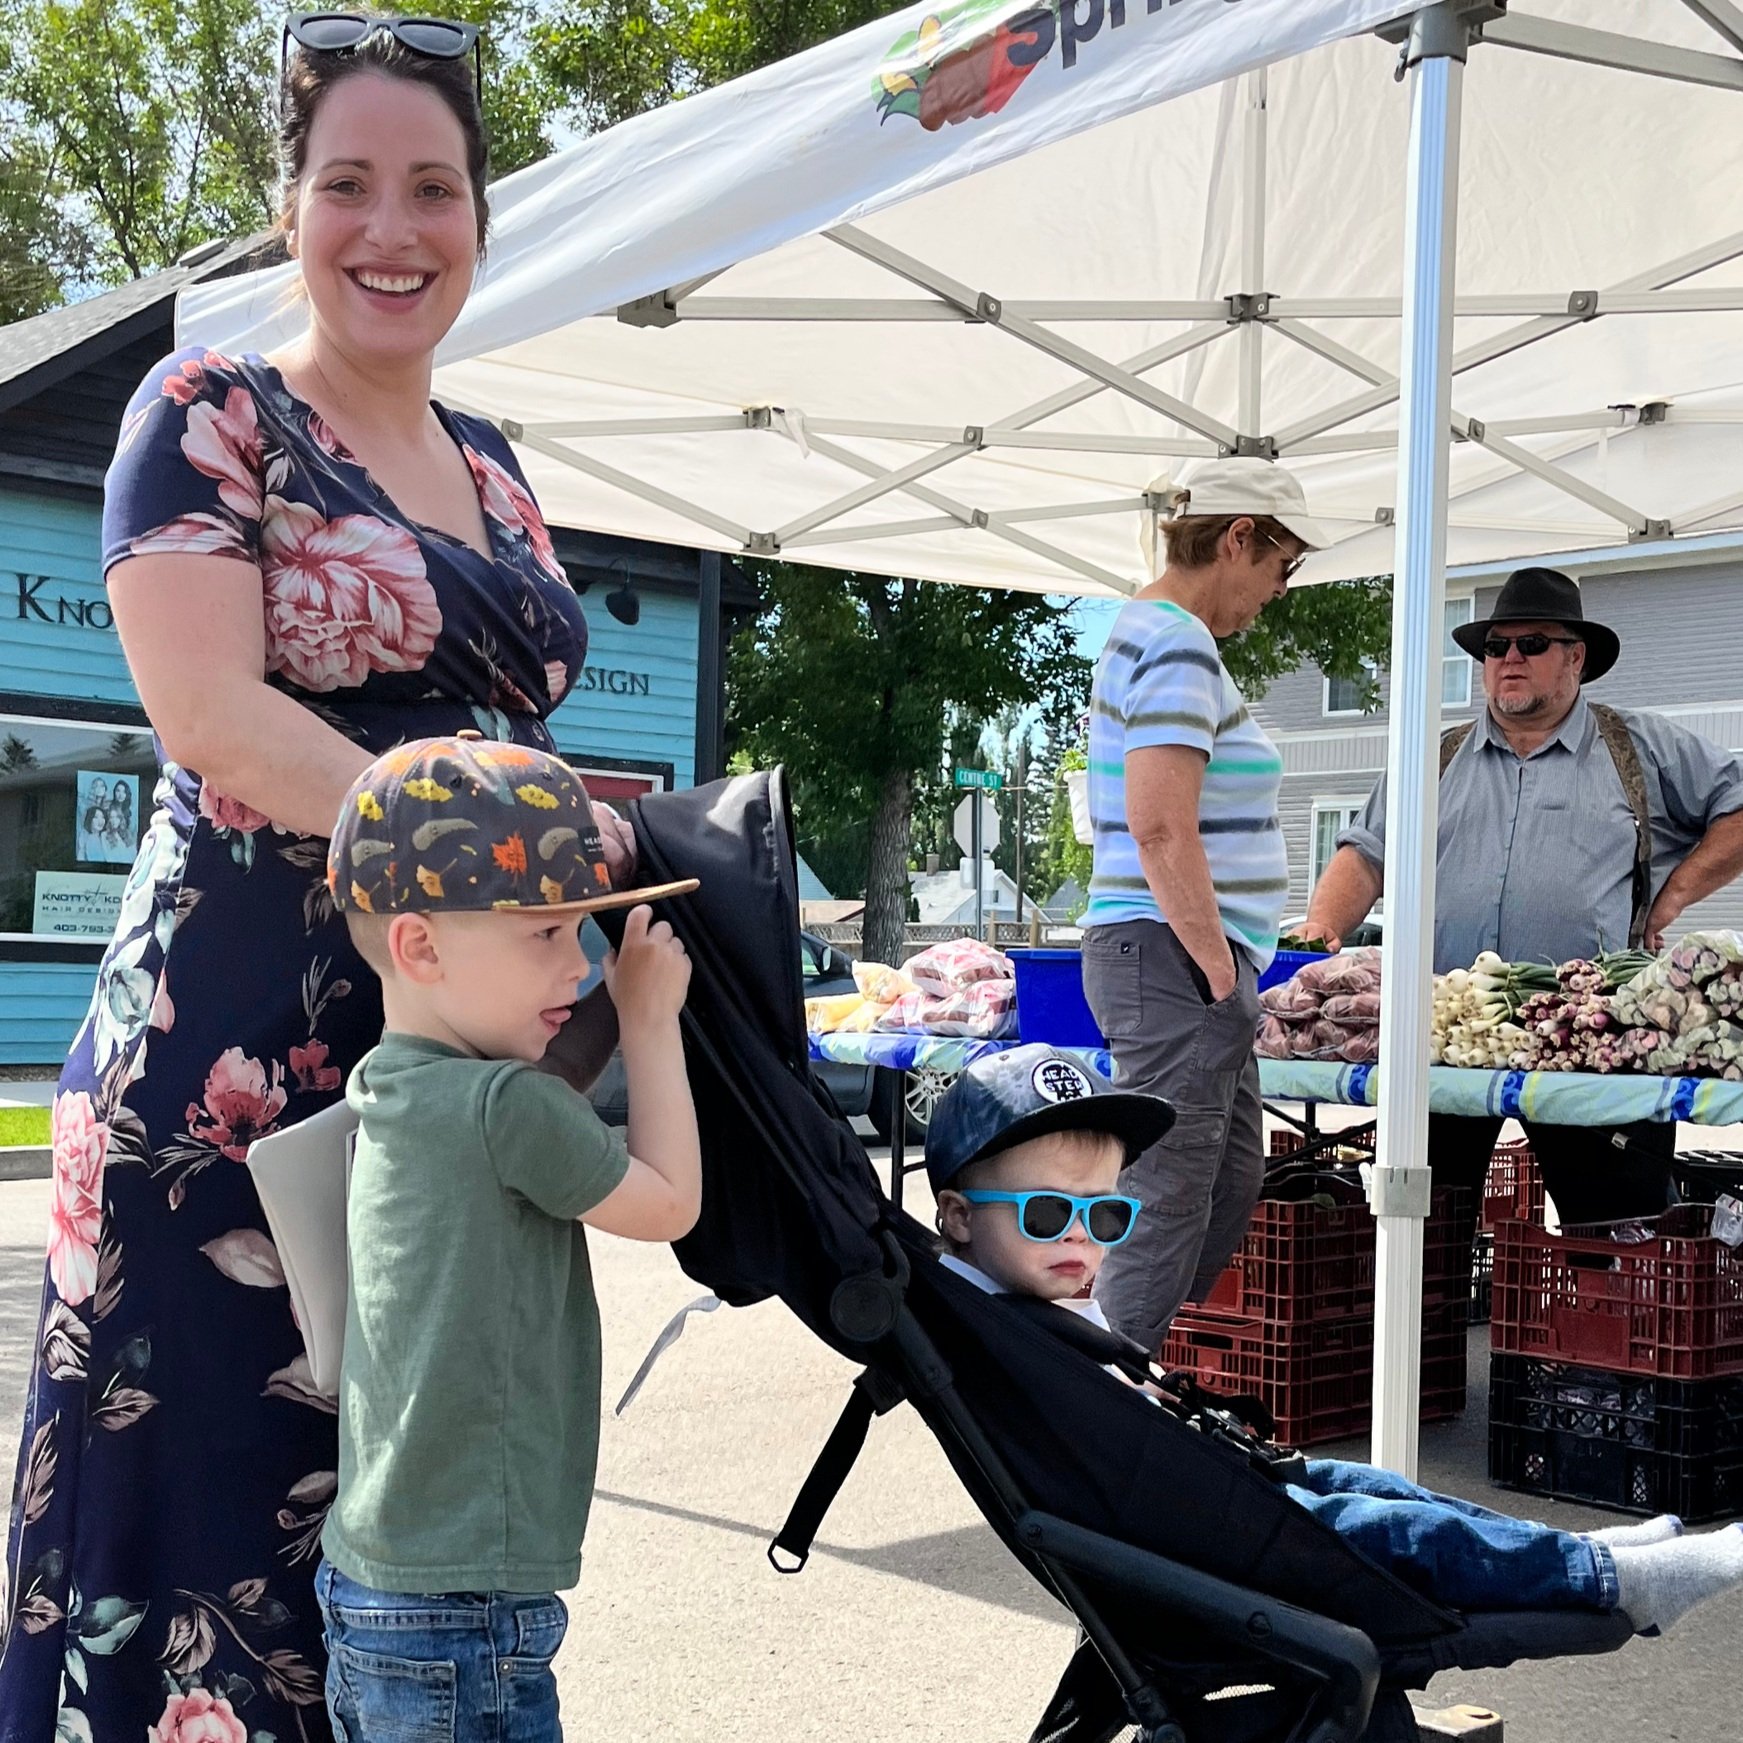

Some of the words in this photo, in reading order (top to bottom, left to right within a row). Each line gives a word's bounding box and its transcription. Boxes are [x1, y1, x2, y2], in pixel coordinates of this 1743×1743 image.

[16, 573, 114, 629] KNO
[575, 666, 650, 696] SIGN
[960, 770, 986, 786] CENTRE
[989, 774, 998, 787] ST
[42, 893, 91, 902] KNOTTY
[104, 896, 122, 904] KO
[1043, 1069, 1078, 1081] HEAD
[1045, 1080, 1084, 1091] STER
